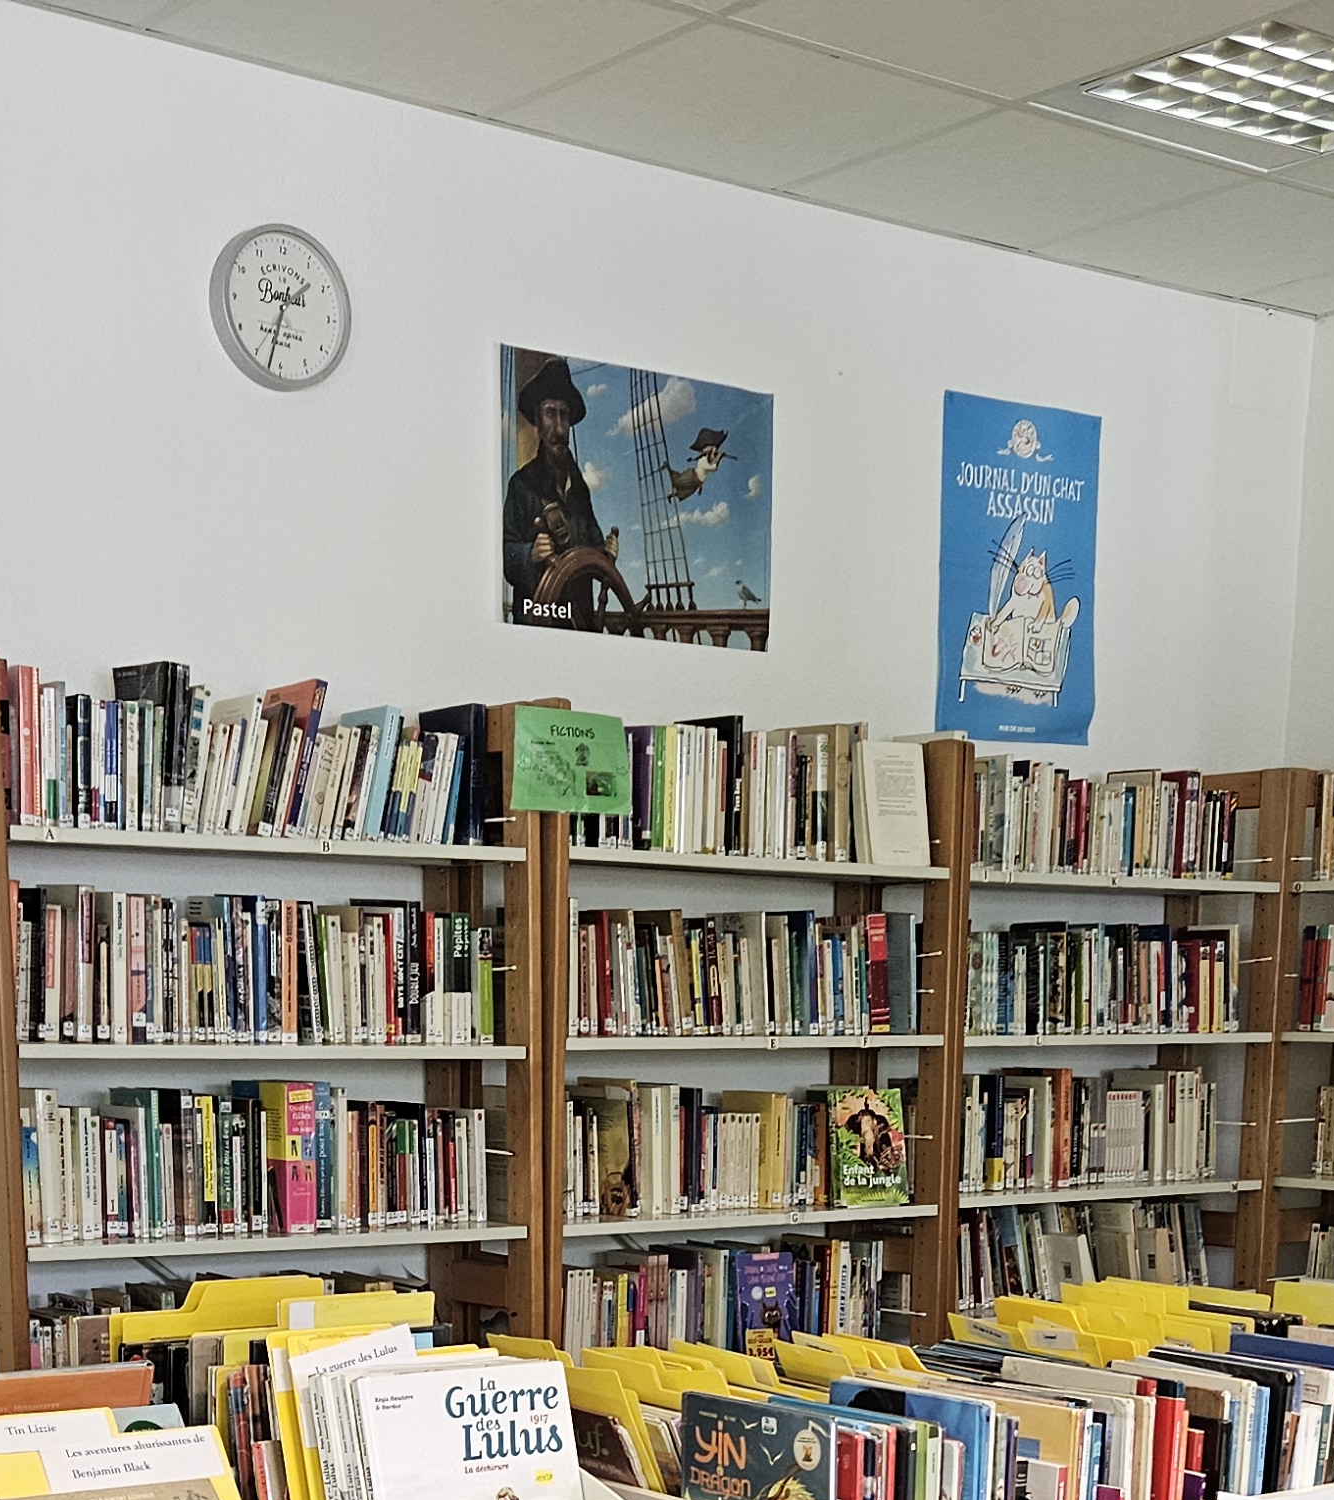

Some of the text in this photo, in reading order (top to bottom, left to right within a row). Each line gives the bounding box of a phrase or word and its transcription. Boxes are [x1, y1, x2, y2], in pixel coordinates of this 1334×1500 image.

[255, 249, 263, 258] 11
[278, 246, 288, 256] 12
[237, 265, 246, 274] 10
[258, 277, 306, 308] Bonhur
[956, 461, 1085, 501] JOURNAL D'UN CHAT
[986, 490, 1055, 525] ASSASSIN
[522, 598, 573, 621] Pastel
[550, 724, 595, 740] FICTIONS
[843, 1165, 875, 1177] Enfant
[844, 1174, 902, 1190] de la jungle
[330, 1358, 356, 1373] guerre
[358, 1352, 372, 1363] des
[374, 1345, 397, 1359] Lulus
[480, 1377, 496, 1392] La
[445, 1386, 559, 1419] Guerre
[475, 1417, 501, 1432] des
[529, 1414, 549, 1425] 1917
[5, 1423, 57, 1436] Tin Lizzie
[65, 1434, 205, 1459] Les aventures ahurissantes de
[462, 1420, 563, 1462] Lulus
[72, 1461, 152, 1480] Benjamin Black
